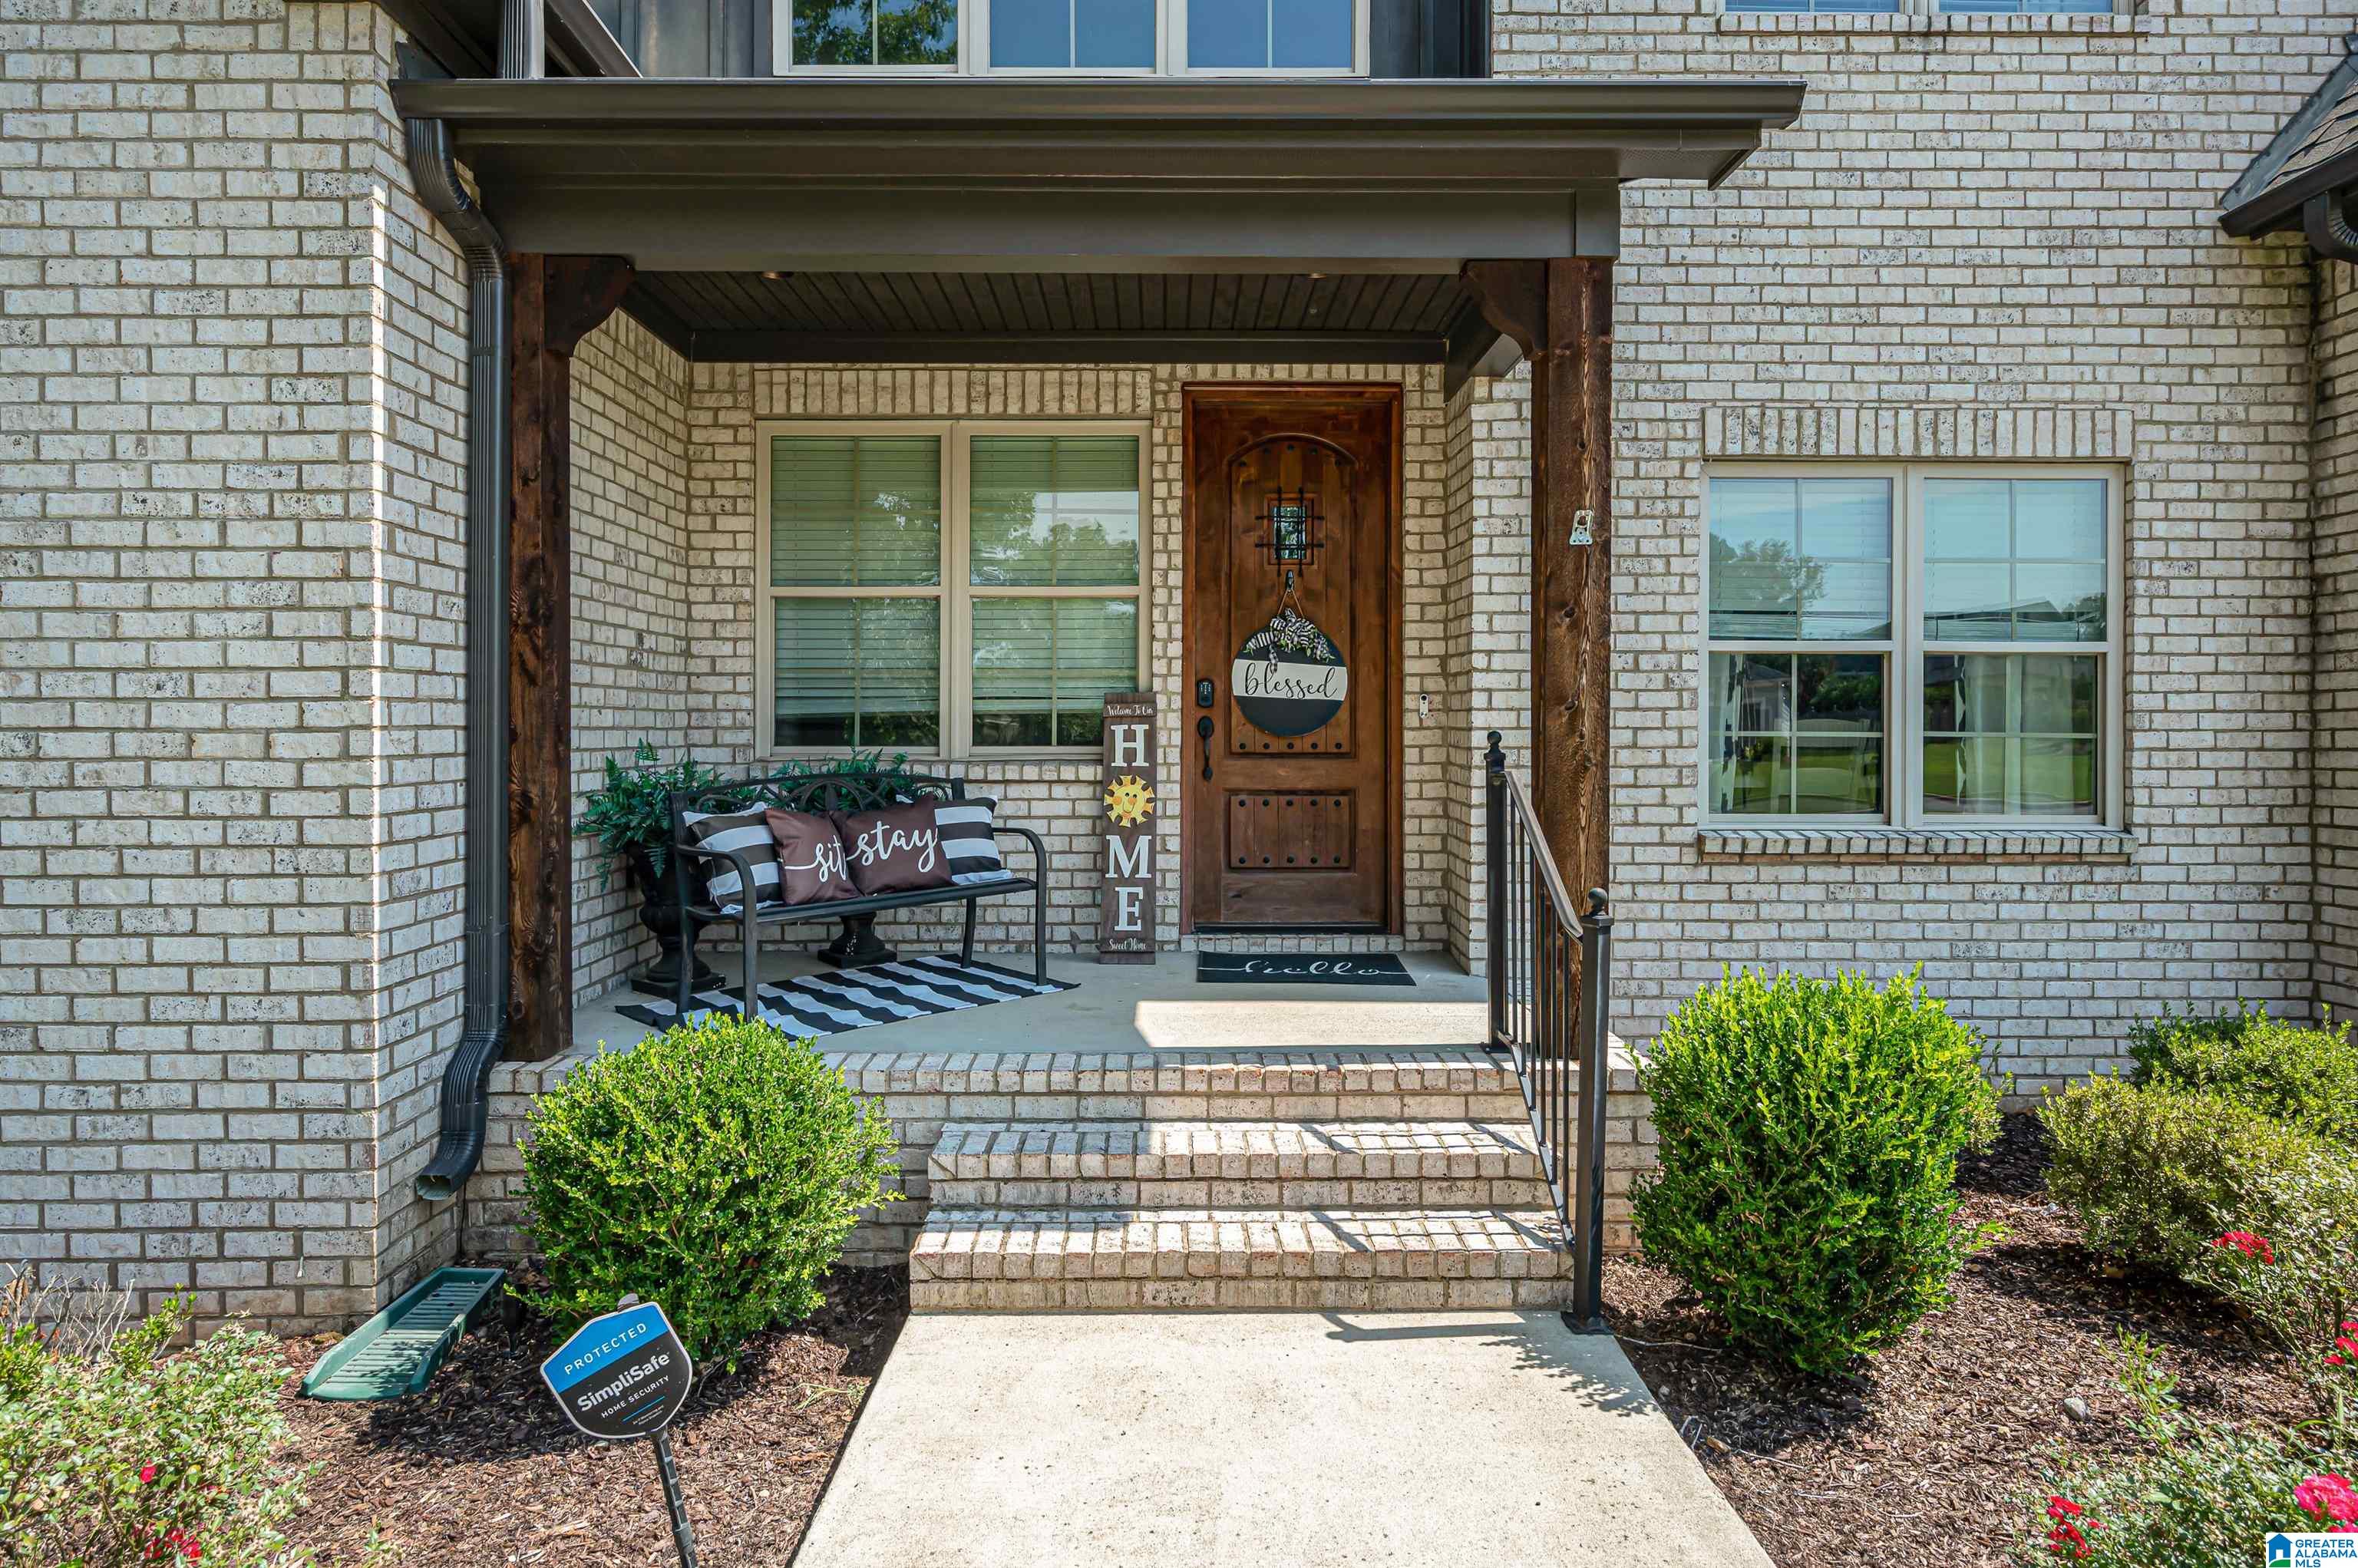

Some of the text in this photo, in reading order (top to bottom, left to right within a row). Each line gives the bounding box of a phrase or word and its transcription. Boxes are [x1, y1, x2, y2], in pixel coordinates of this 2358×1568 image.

[1244, 662, 1338, 699] blessed
[846, 820, 938, 873] stay
[564, 1322, 647, 1375] PROTECTED
[577, 1352, 670, 1411] SimpliSafe
[601, 1400, 627, 1418] HOME
[628, 1375, 669, 1403] SECURITY
